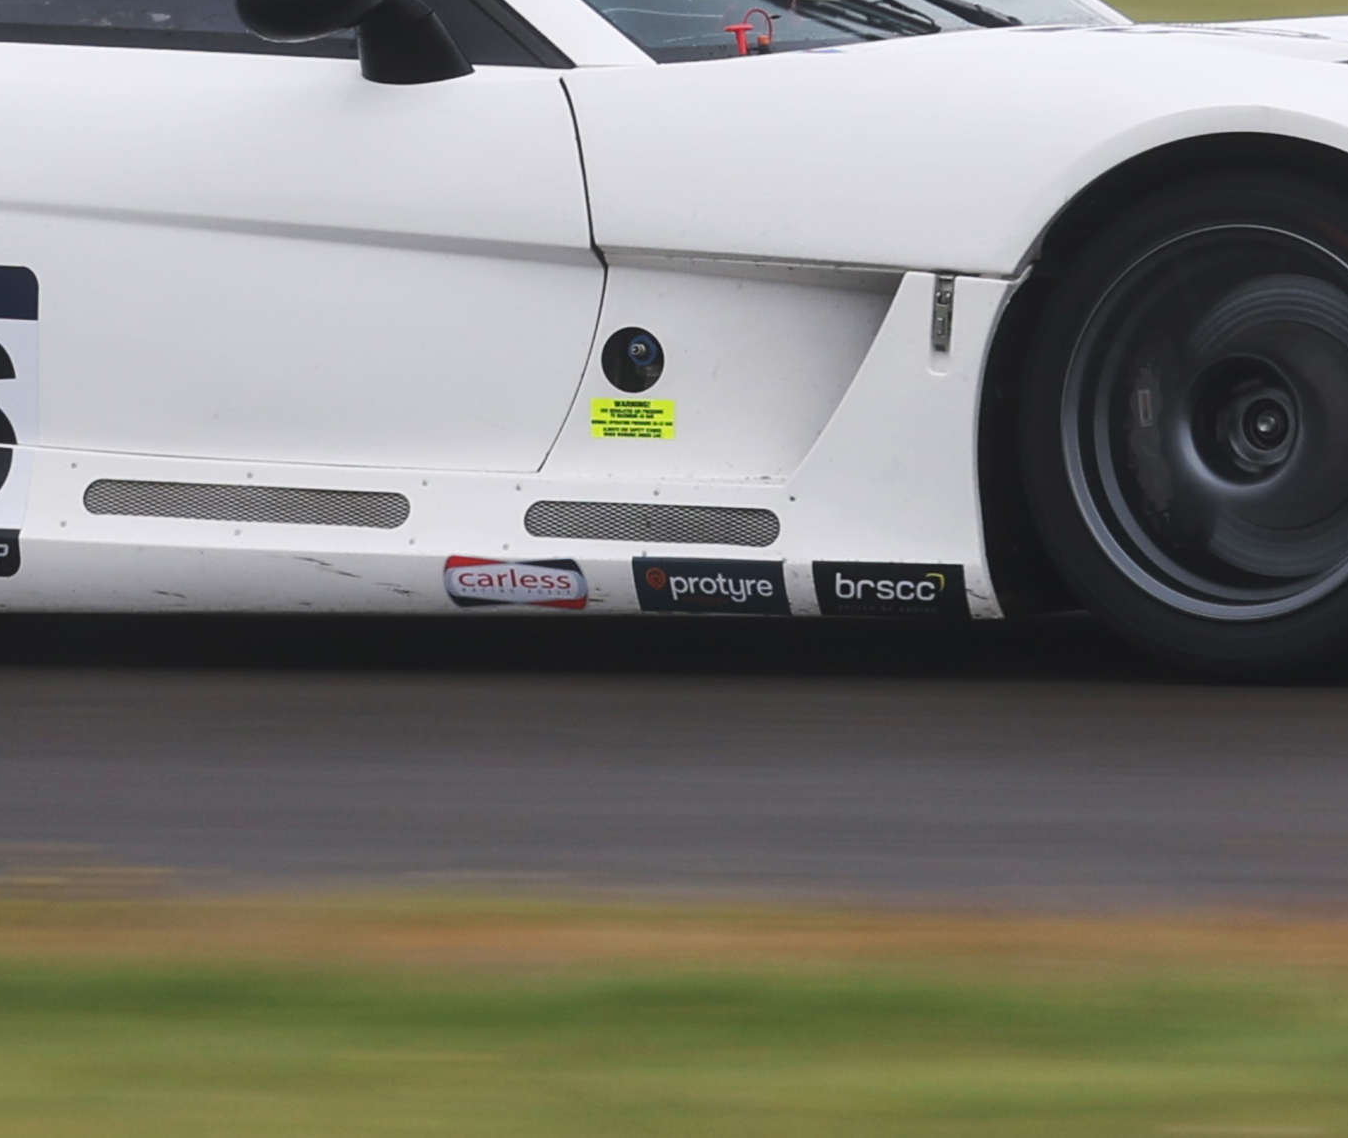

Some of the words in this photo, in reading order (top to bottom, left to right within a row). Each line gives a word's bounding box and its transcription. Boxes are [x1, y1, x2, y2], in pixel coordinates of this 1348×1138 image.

[458, 568, 571, 590] carless
[669, 573, 774, 603] protyre
[835, 572, 936, 601] brscc
